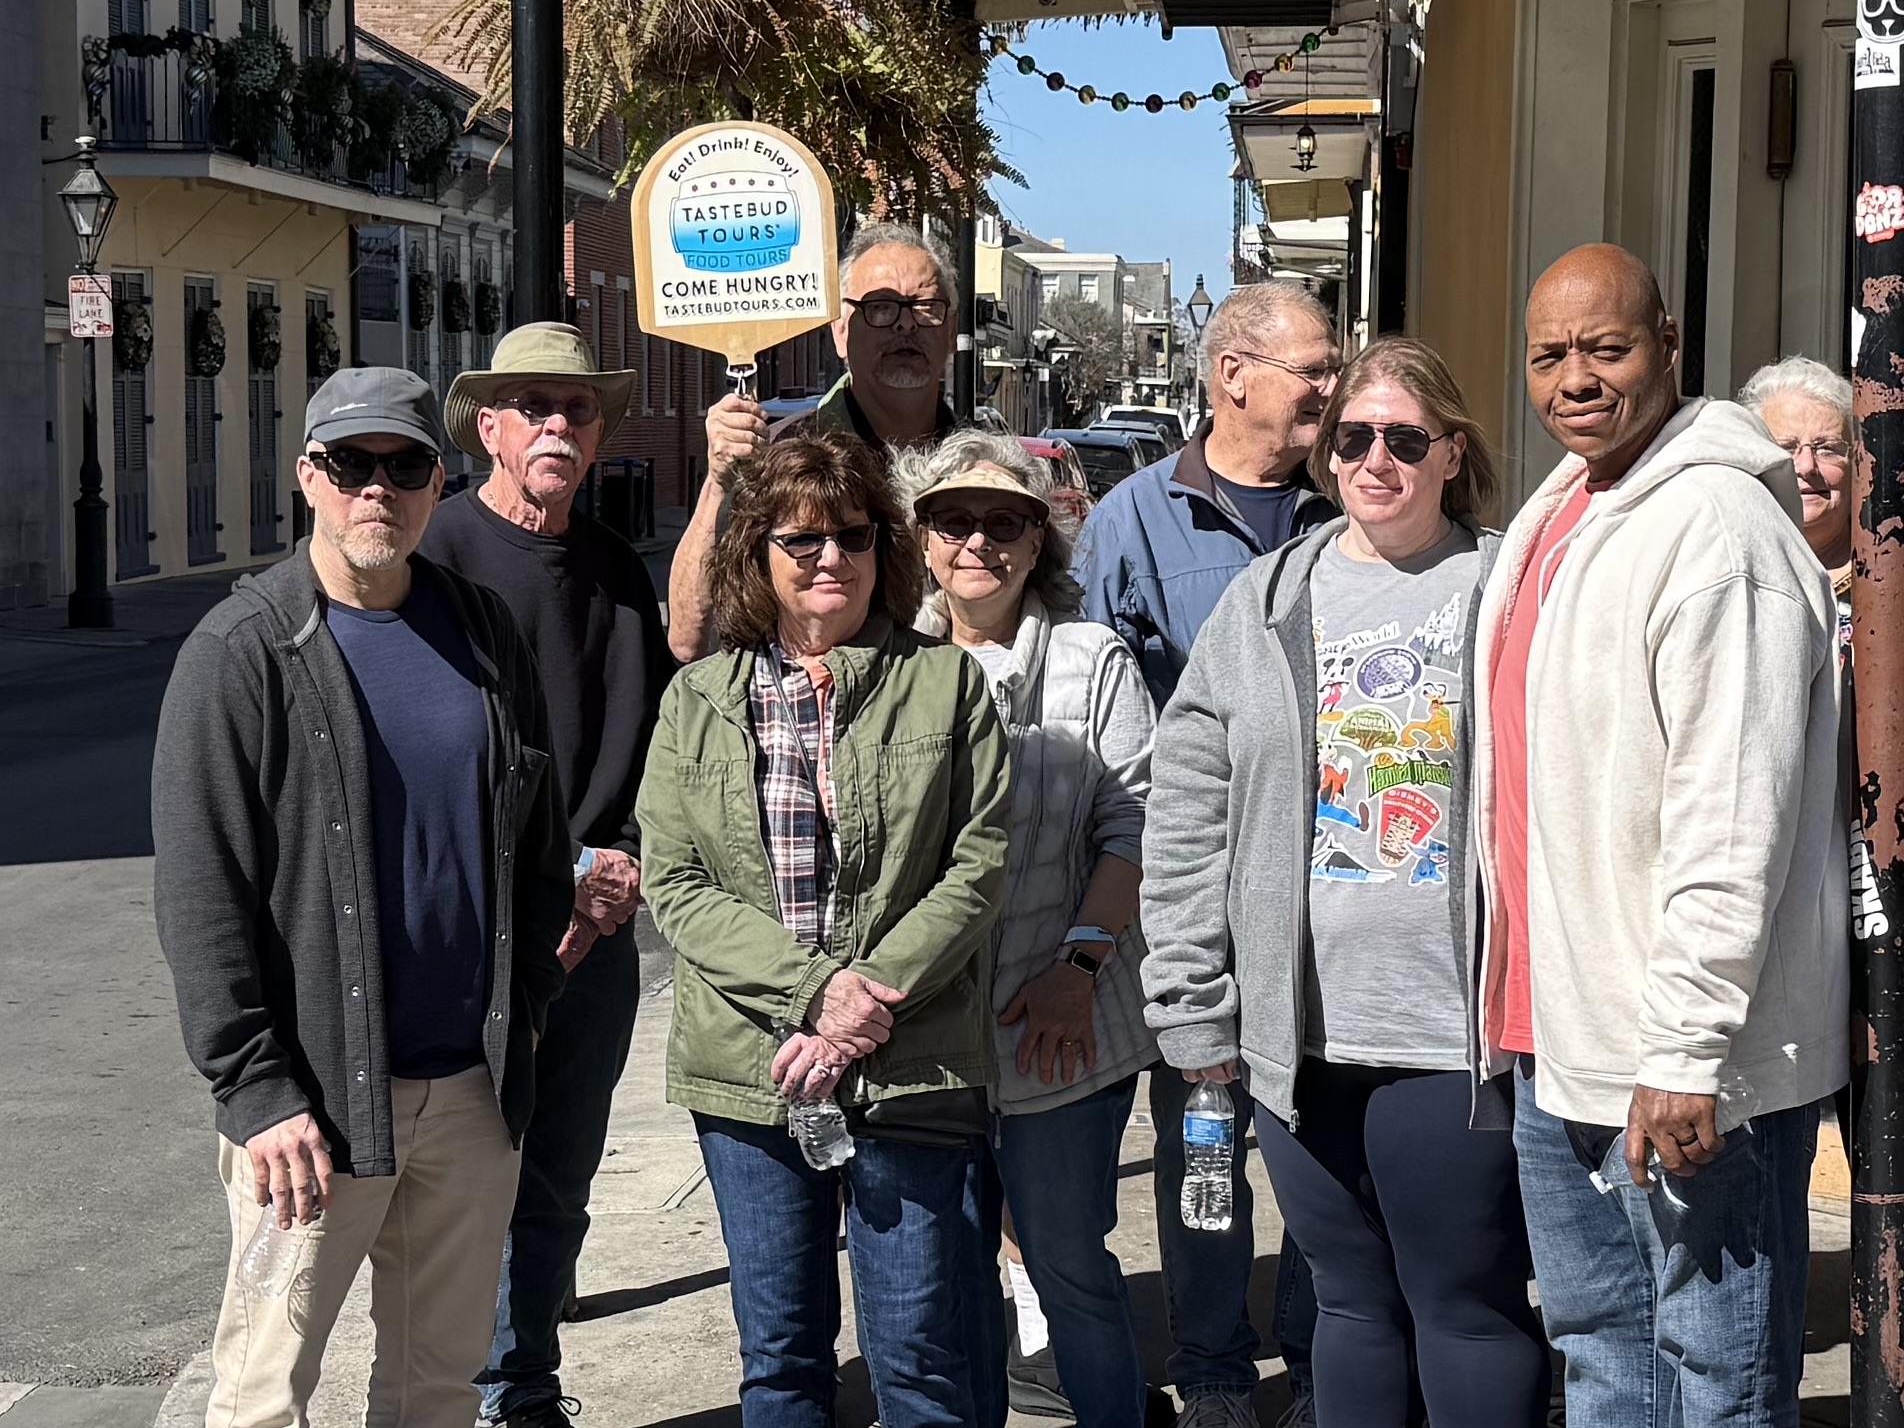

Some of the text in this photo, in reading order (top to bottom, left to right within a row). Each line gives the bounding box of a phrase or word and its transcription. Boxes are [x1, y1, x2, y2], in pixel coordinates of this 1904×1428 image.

[669, 136, 799, 182] Eat! Drink! Enjoy!
[682, 200, 788, 223] TASTEBUD
[686, 247, 789, 270] FOOD TOURS
[661, 272, 820, 299] COME HUNGRY!
[80, 296, 101, 306] FIRE
[663, 296, 820, 317] TASTEBUDTOURS.COM
[79, 308, 104, 319] LANE
